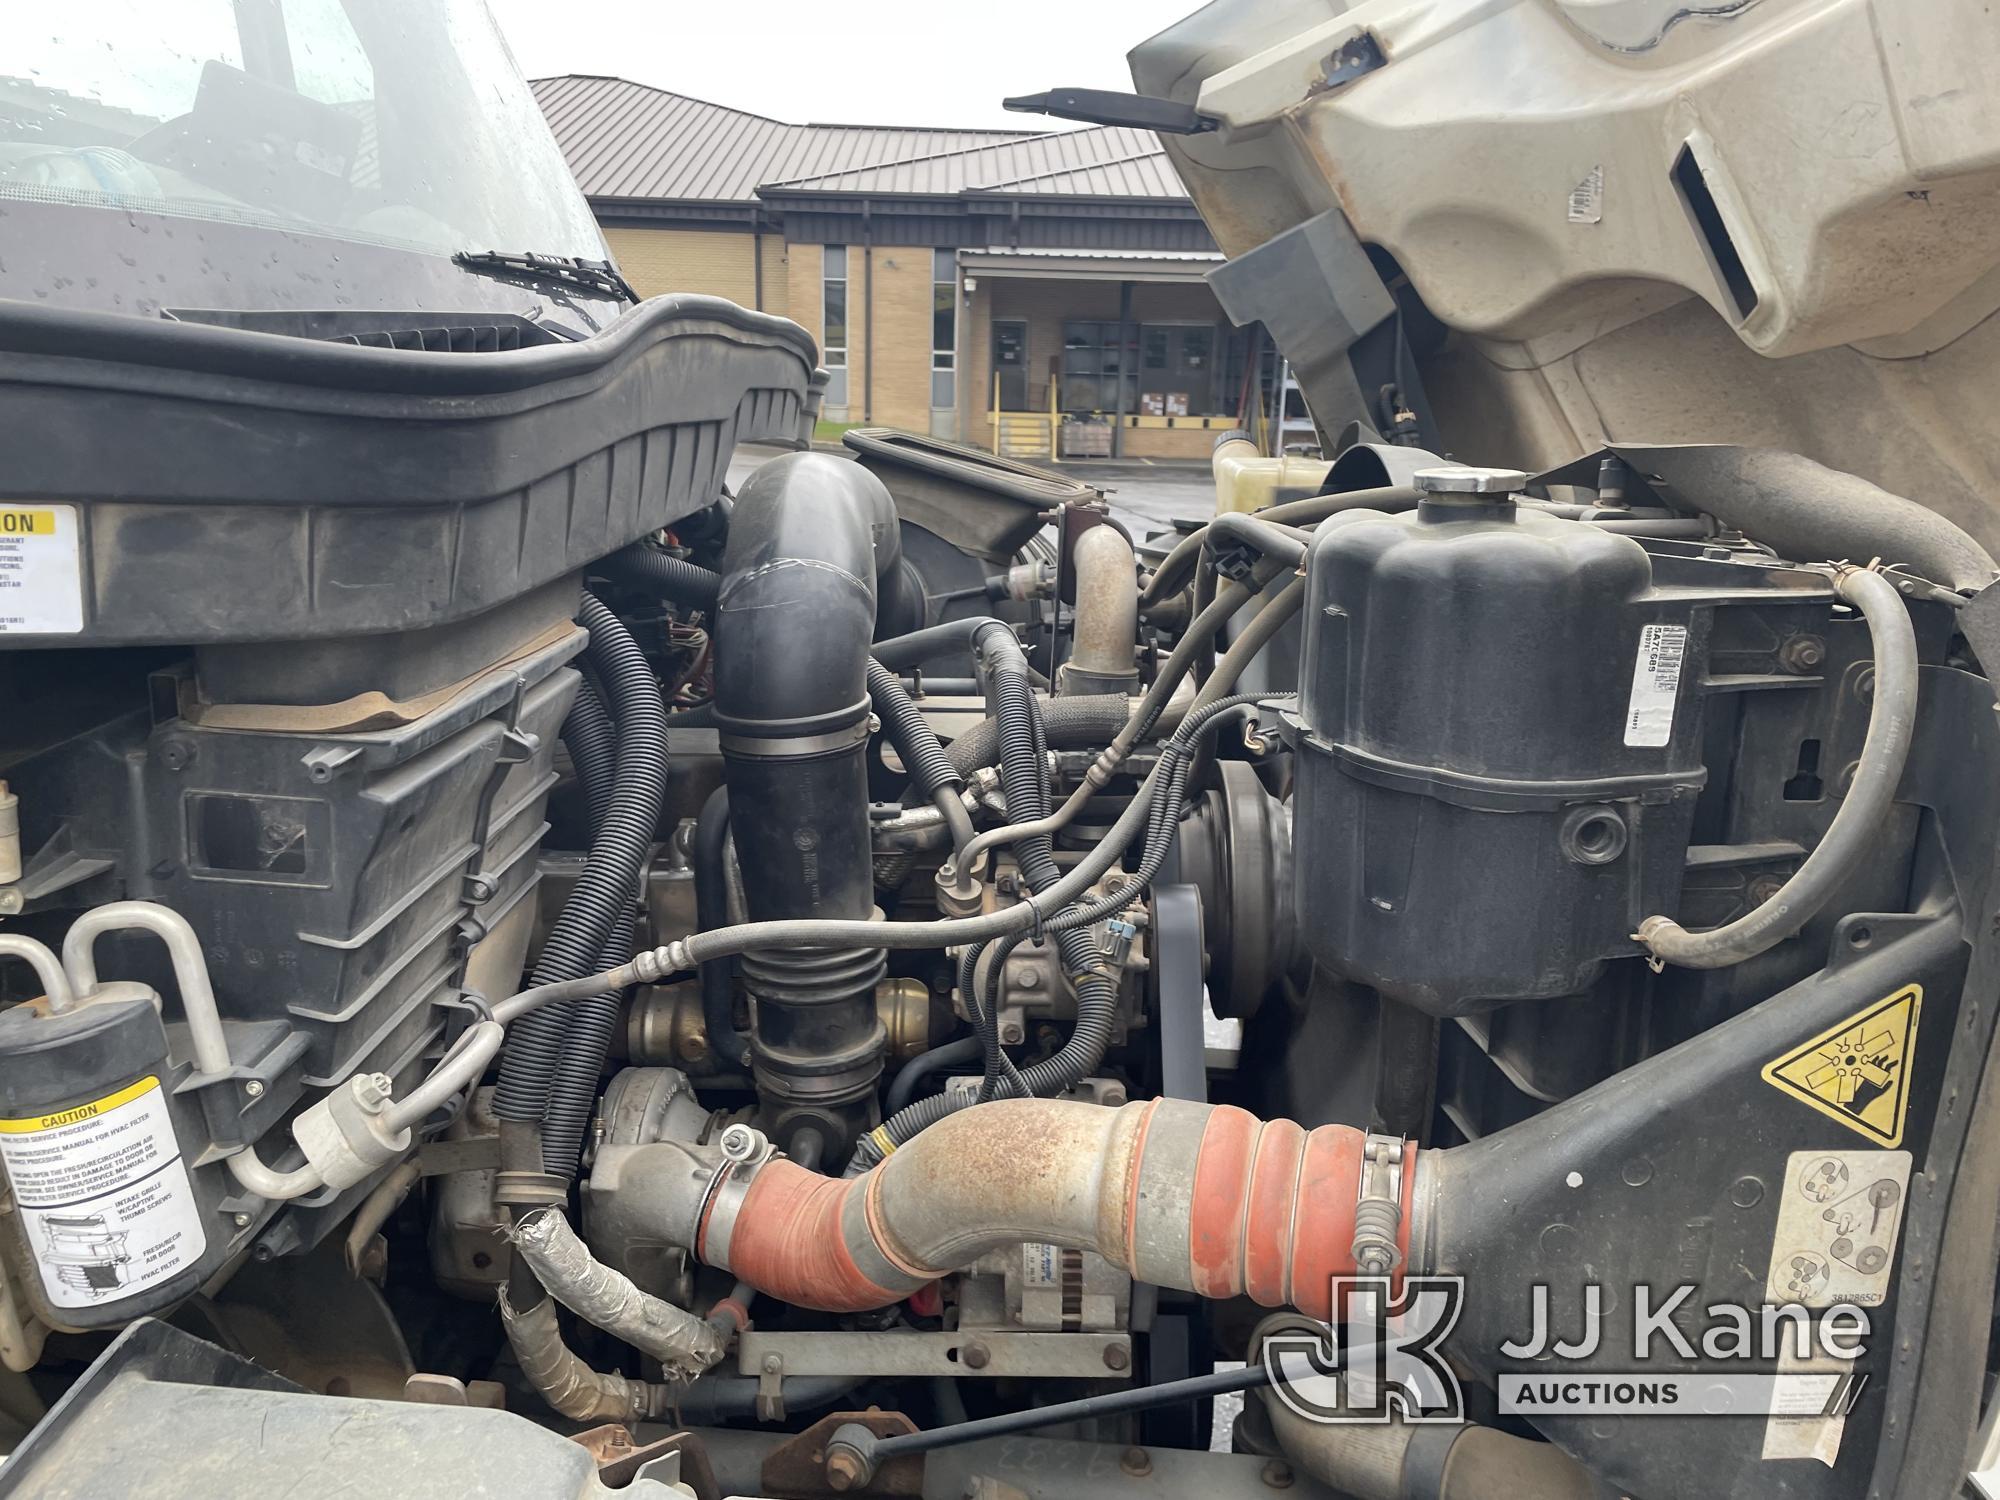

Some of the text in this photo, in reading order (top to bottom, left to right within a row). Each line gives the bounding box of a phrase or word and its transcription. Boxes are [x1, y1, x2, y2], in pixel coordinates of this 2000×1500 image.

[42, 1104, 98, 1128] CAUTION
[31, 1133, 57, 1143] SERVICE
[62, 1137, 94, 1151] MANUAL
[95, 1131, 110, 1142] FOR
[111, 1124, 130, 1136] HVAC
[130, 1112, 150, 1127] FILTER
[47, 1175, 70, 1185] RESULT
[81, 1162, 113, 1177] DAMAGE
[115, 1158, 124, 1166] TO
[125, 1149, 144, 1161] DOOR
[145, 1143, 154, 1152] OR
[64, 1141, 142, 1173] FRESH/RECIRCULATION
[143, 1134, 154, 1145] AIR
[57, 1170, 114, 1191] OWNER/SERVICE
[115, 1158, 145, 1174] MANUAL
[145, 1149, 158, 1160] FOR
[58, 1187, 85, 1199] SERVICE
[86, 1173, 131, 1192] PROCEDURE.
[115, 1181, 162, 1208] INTAKE GRILLE
[117, 1194, 155, 1215] W/CAPTIVE
[120, 1193, 172, 1223] THUMB SCREWS
[142, 1231, 182, 1257] FRESH/RECIR
[145, 1244, 176, 1265] AIR DOOR
[141, 1256, 180, 1281] HVAC FILTER
